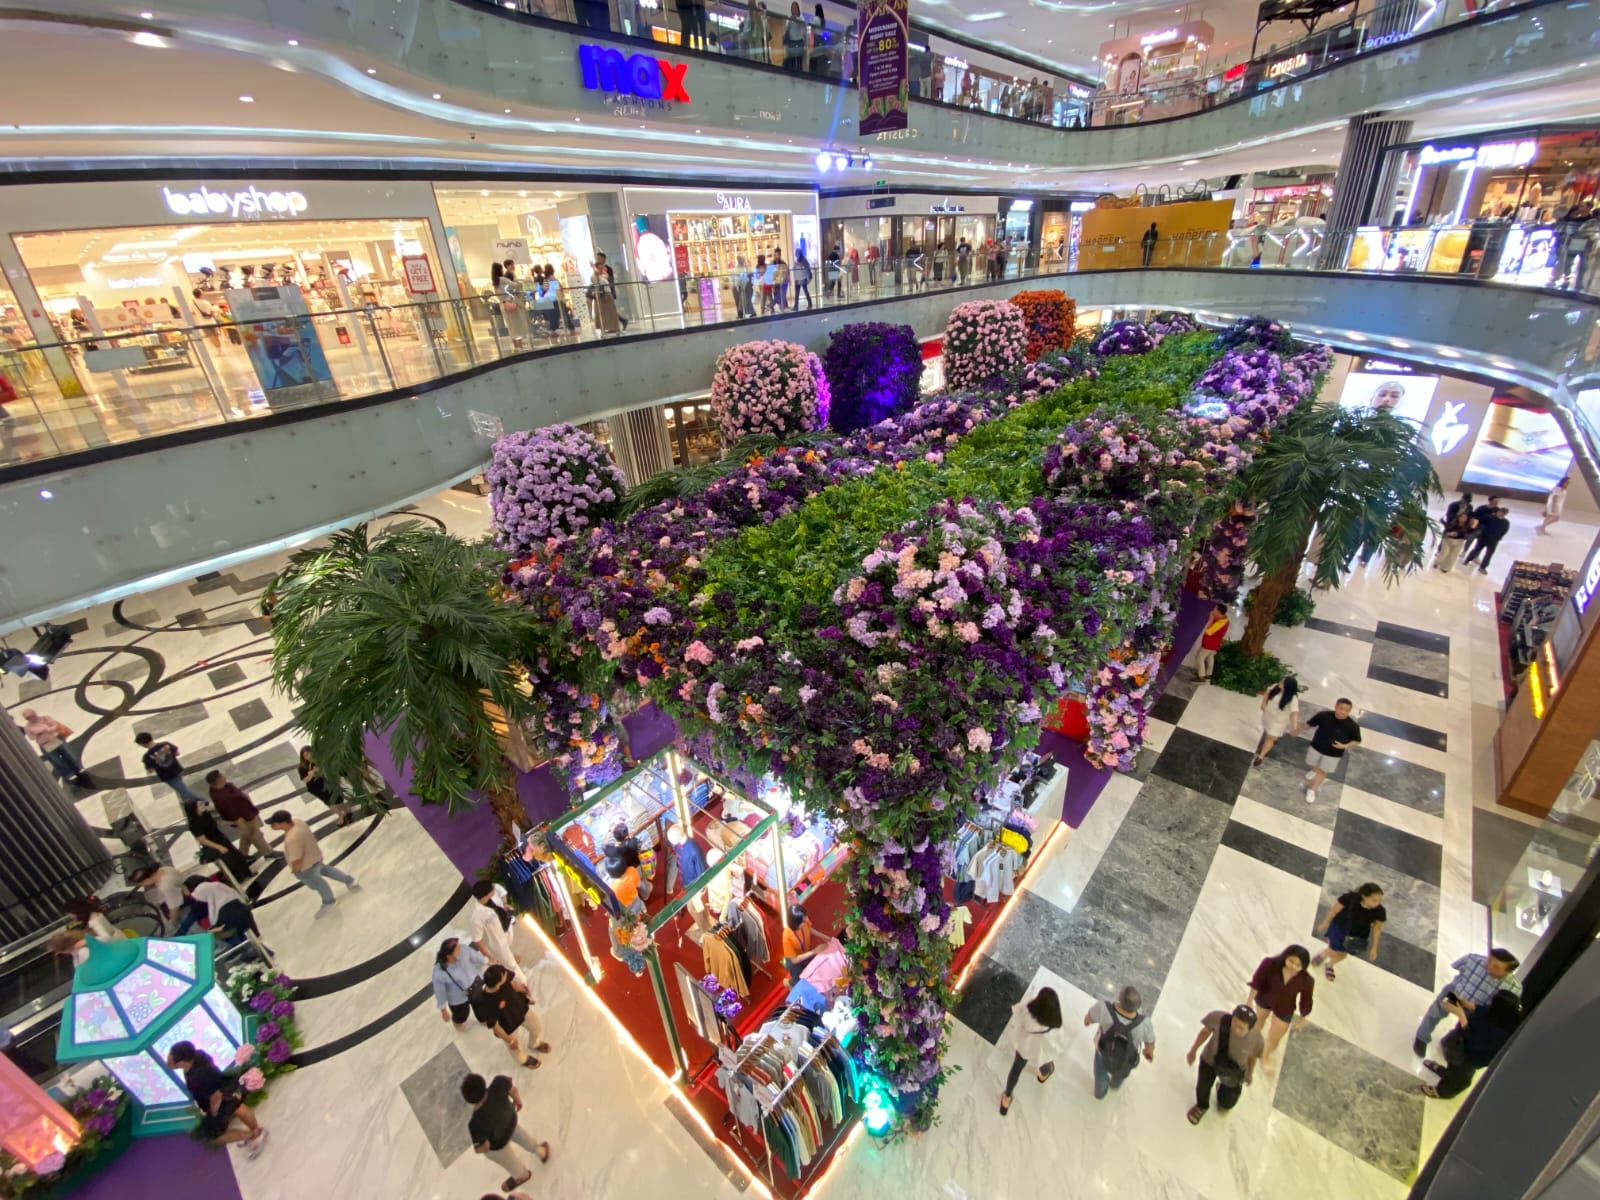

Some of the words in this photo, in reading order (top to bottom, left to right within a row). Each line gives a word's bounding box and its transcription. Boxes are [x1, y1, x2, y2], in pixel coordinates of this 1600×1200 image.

[578, 44, 691, 103] max
[162, 185, 307, 218] babyshop
[722, 197, 751, 211] AURA
[496, 241, 522, 249] nuna
